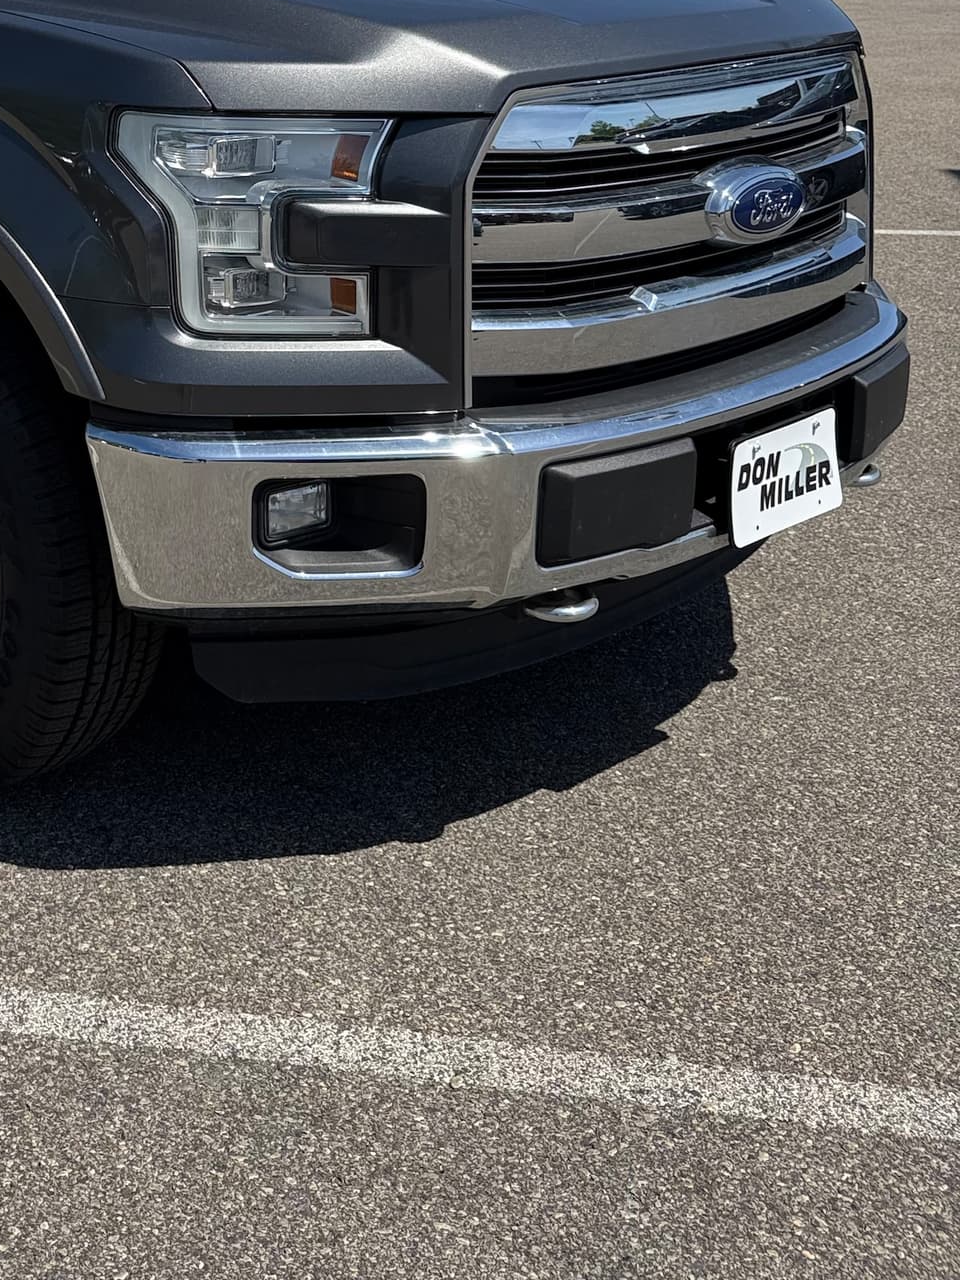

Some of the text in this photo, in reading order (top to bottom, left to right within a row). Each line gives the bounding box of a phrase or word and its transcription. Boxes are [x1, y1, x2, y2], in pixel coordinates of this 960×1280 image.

[750, 187, 794, 226] Ford
[737, 450, 782, 492] DON
[759, 459, 832, 512] MILLER
